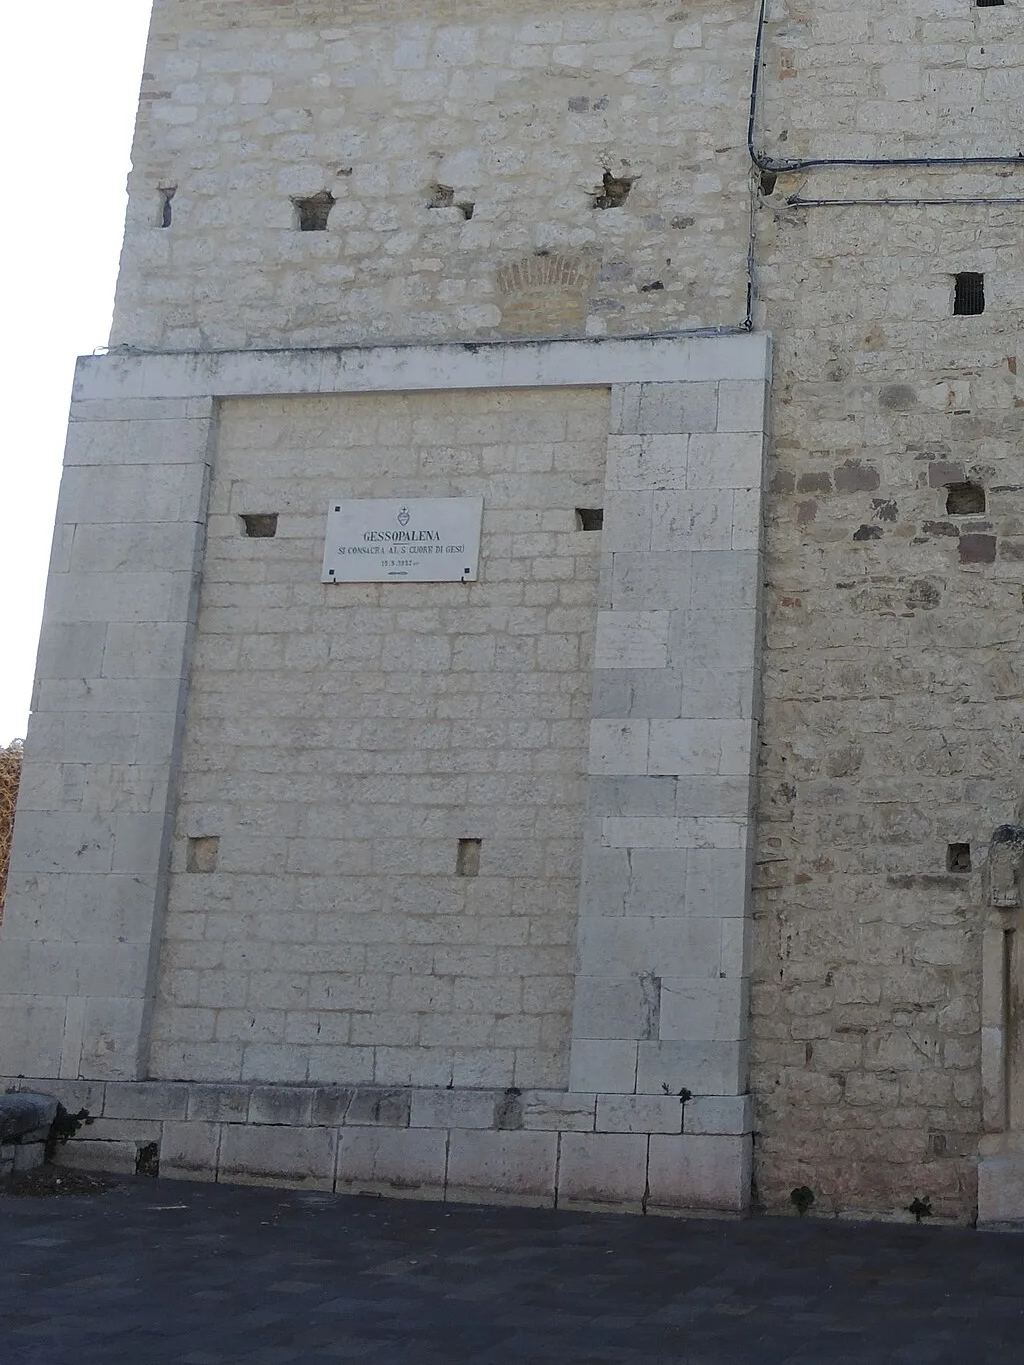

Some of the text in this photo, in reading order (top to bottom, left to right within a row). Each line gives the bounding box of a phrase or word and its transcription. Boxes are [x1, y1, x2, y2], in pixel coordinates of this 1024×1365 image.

[363, 530, 441, 542] GESSOPALENA
[338, 546, 346, 555] SI
[347, 546, 385, 555] CONSACRA
[388, 546, 399, 555] AL
[409, 545, 434, 554] CUORE
[435, 545, 443, 554] DI
